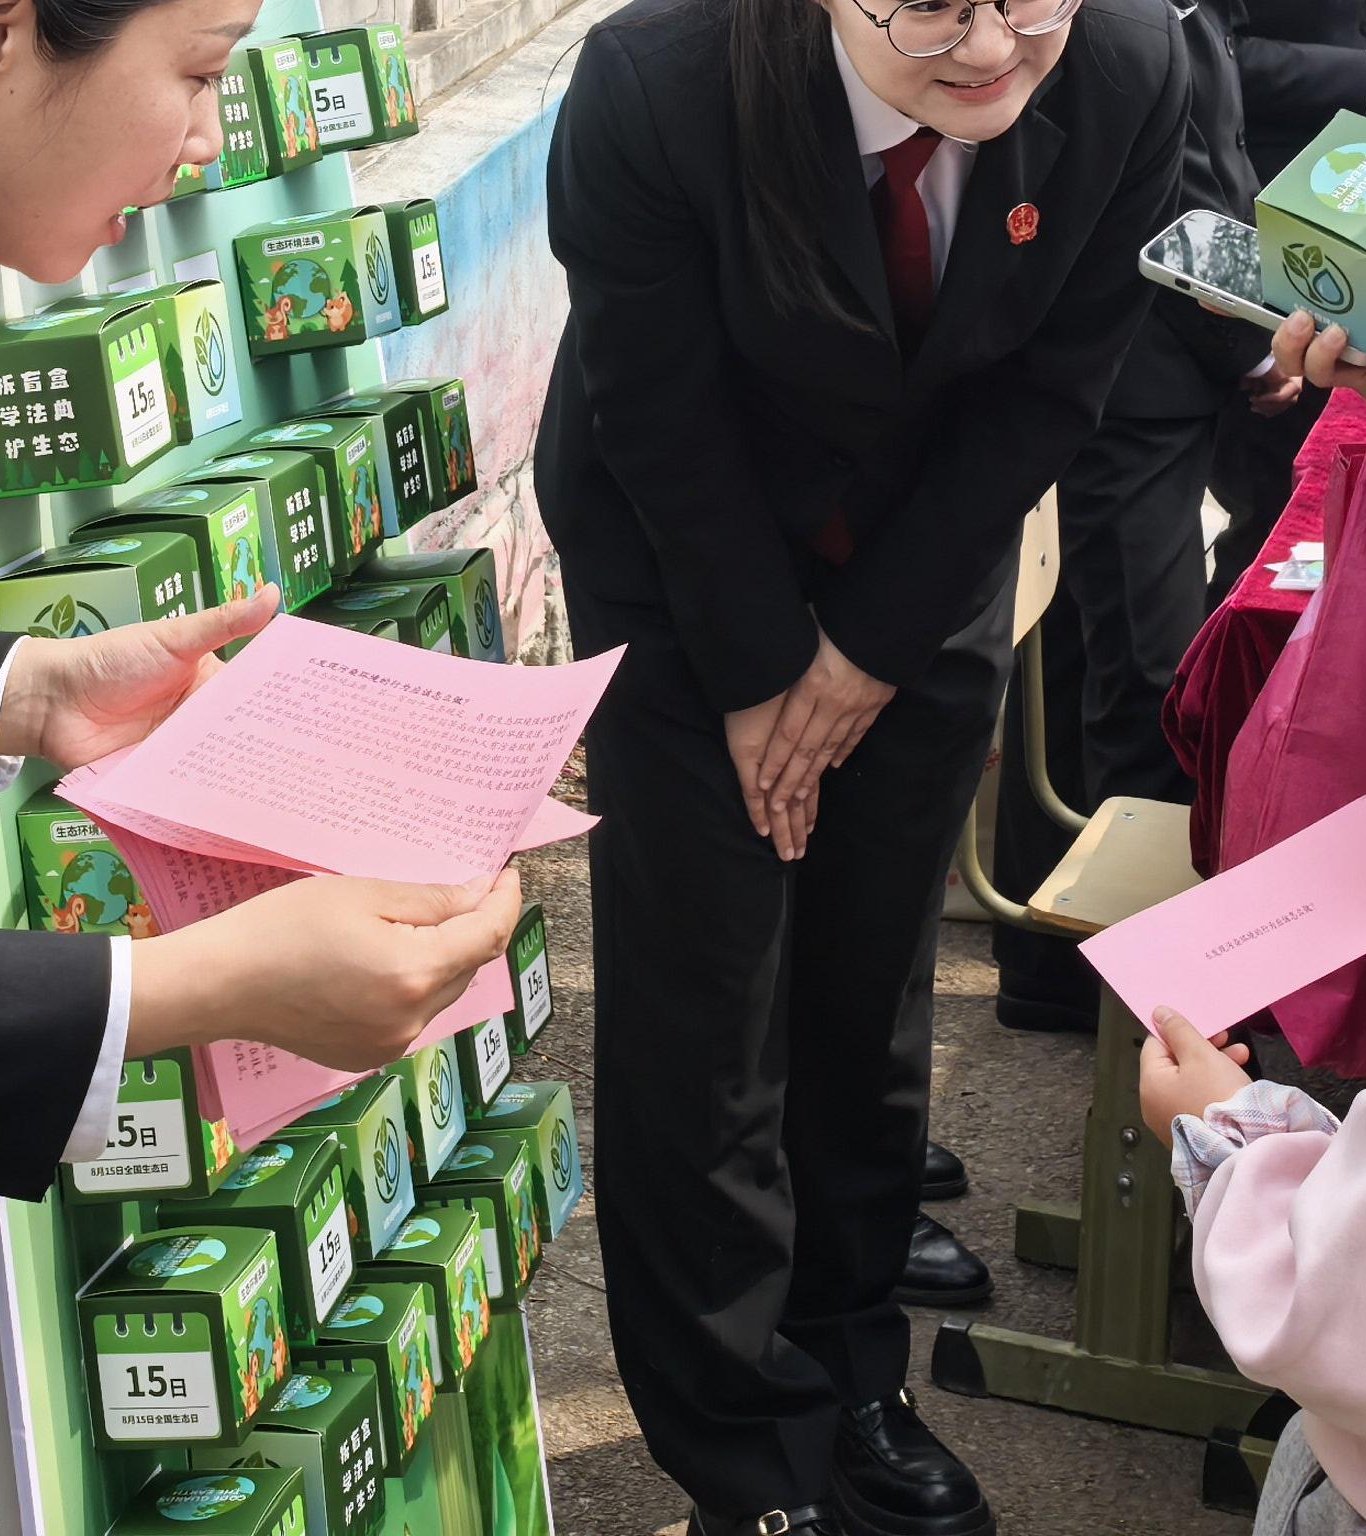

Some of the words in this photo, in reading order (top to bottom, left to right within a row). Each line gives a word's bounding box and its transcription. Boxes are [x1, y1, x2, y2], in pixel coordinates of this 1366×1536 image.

[1332, 169, 1362, 200] EARTH
[266, 236, 320, 252] 生态环境法典
[0, 399, 75, 427] 学法典
[4, 432, 80, 459] 护生态
[56, 823, 106, 839] 生态环境
[106, 1115, 157, 1147] 5日
[91, 1163, 169, 1177] 8月15日全国生态日
[125, 1365, 187, 1398] 15日
[122, 1413, 199, 1425] 8月15日全国生态日
